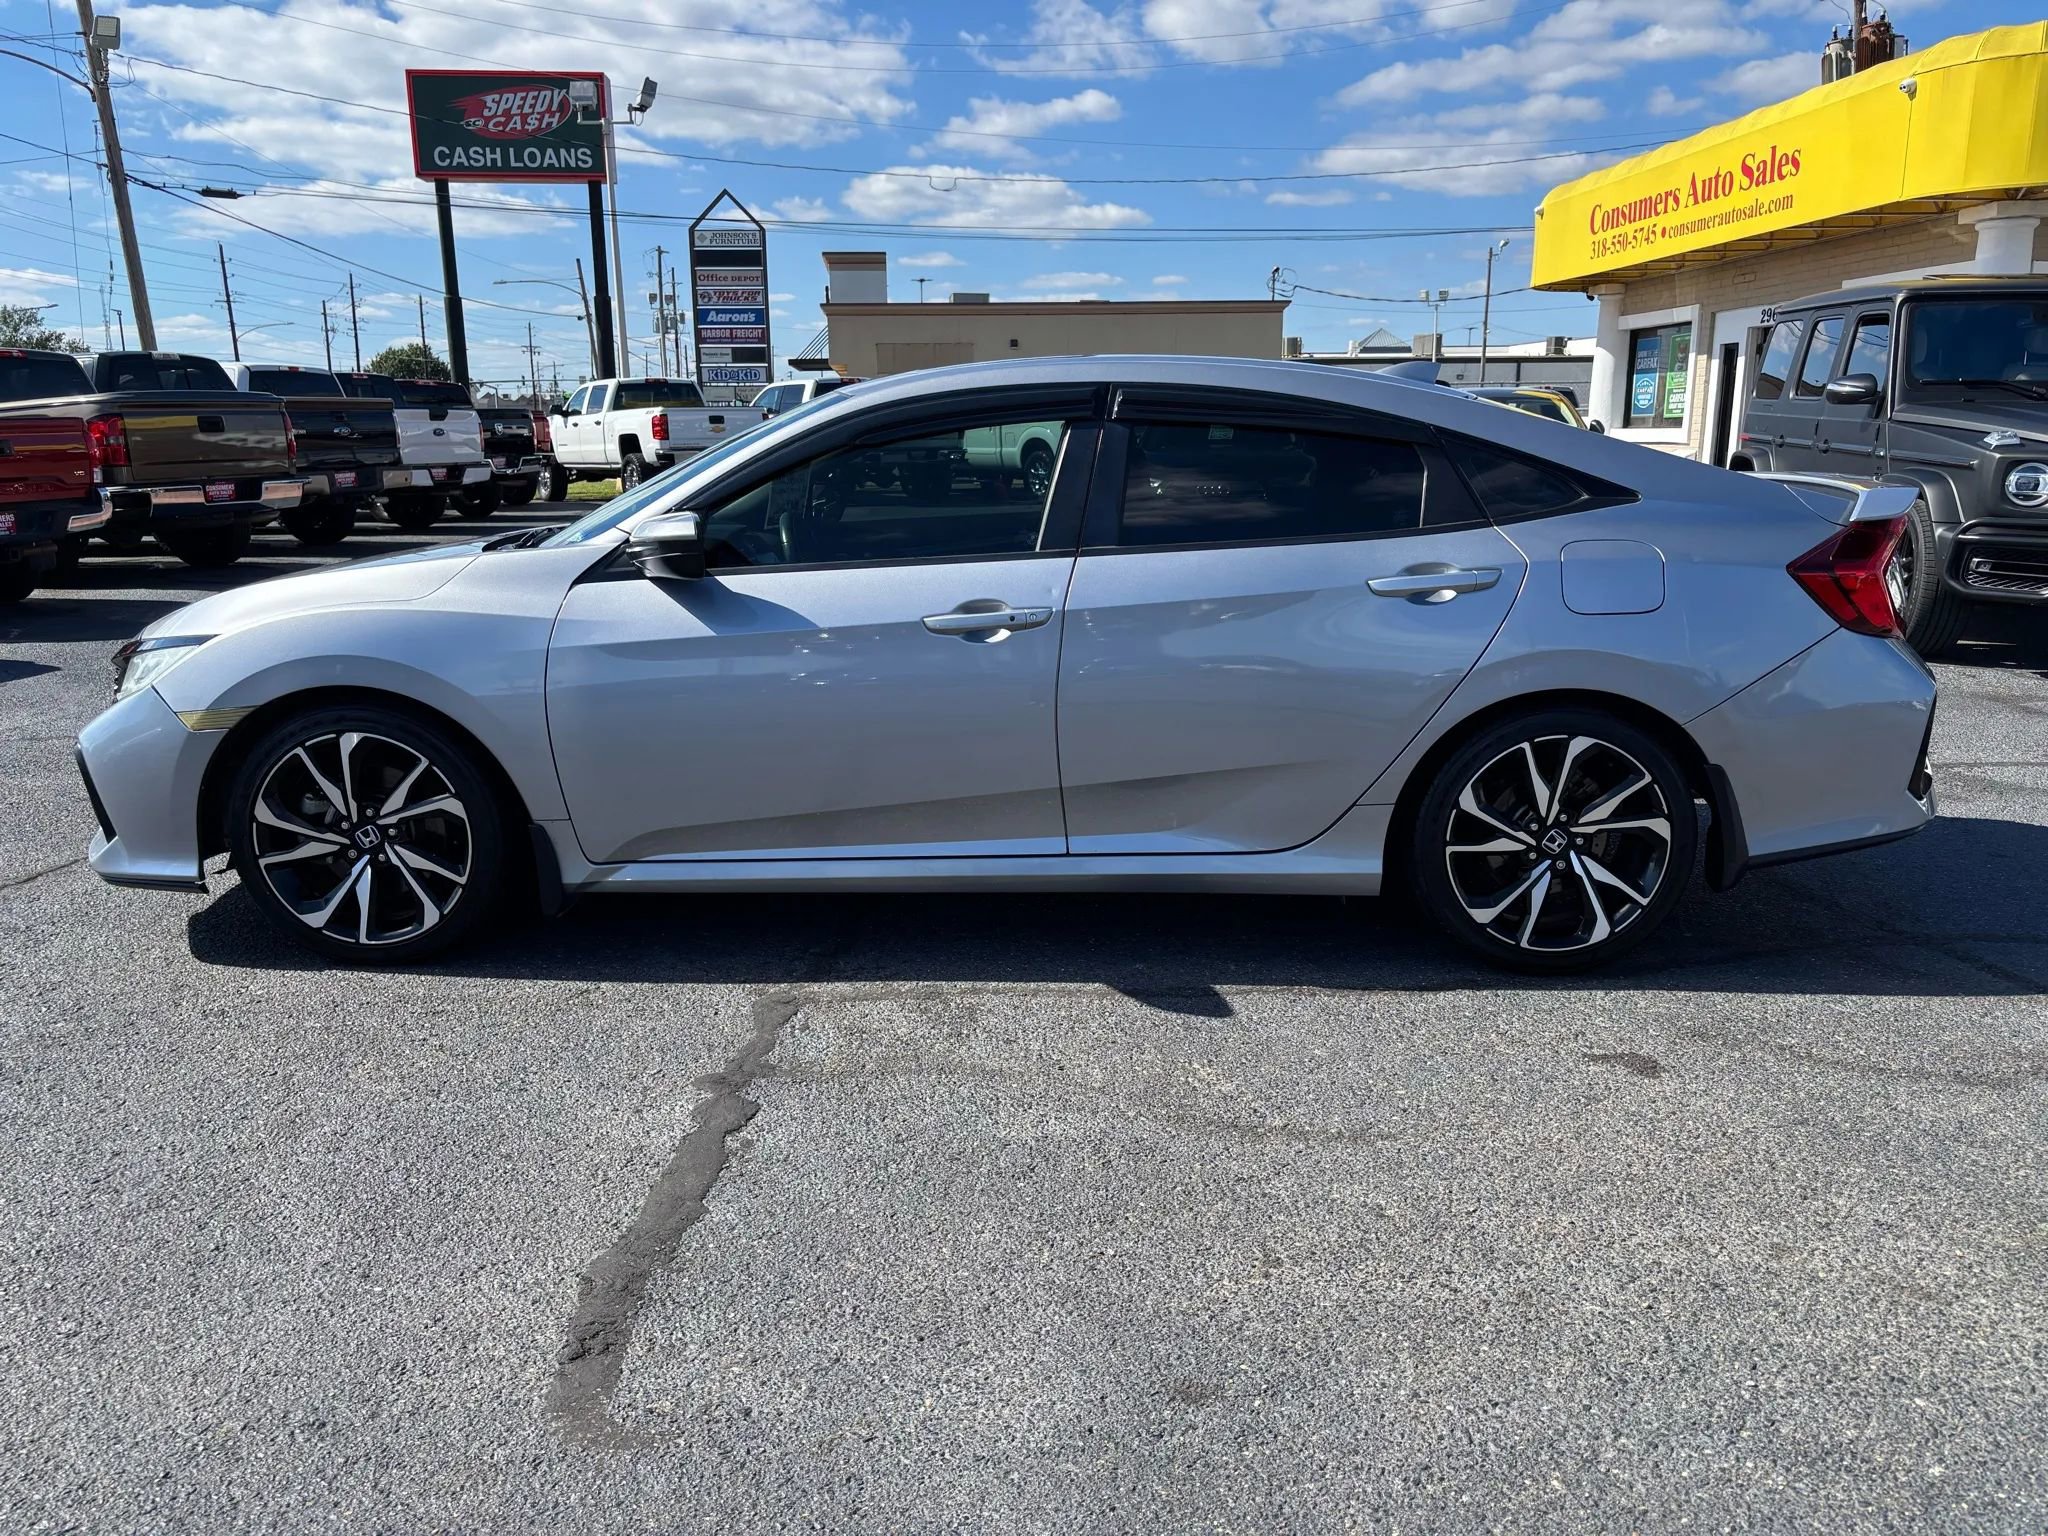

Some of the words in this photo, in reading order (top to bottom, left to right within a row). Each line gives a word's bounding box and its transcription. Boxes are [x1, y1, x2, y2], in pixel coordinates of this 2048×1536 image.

[481, 89, 567, 117] SPEEDY
[433, 146, 501, 168] CASH
[509, 147, 593, 169] LOANS
[1589, 186, 1681, 235] Consumers
[1684, 166, 1734, 209] Auto
[1739, 145, 1802, 192] Sales
[1590, 223, 1657, 260] 318-550-5745
[1668, 194, 1794, 239] consumerautosale.com
[697, 273, 729, 282] Office
[707, 310, 756, 322] Aaron's
[701, 328, 731, 338] HARBOR
[732, 328, 763, 338] FREIGHT
[1636, 357, 1659, 370] CARFAX
